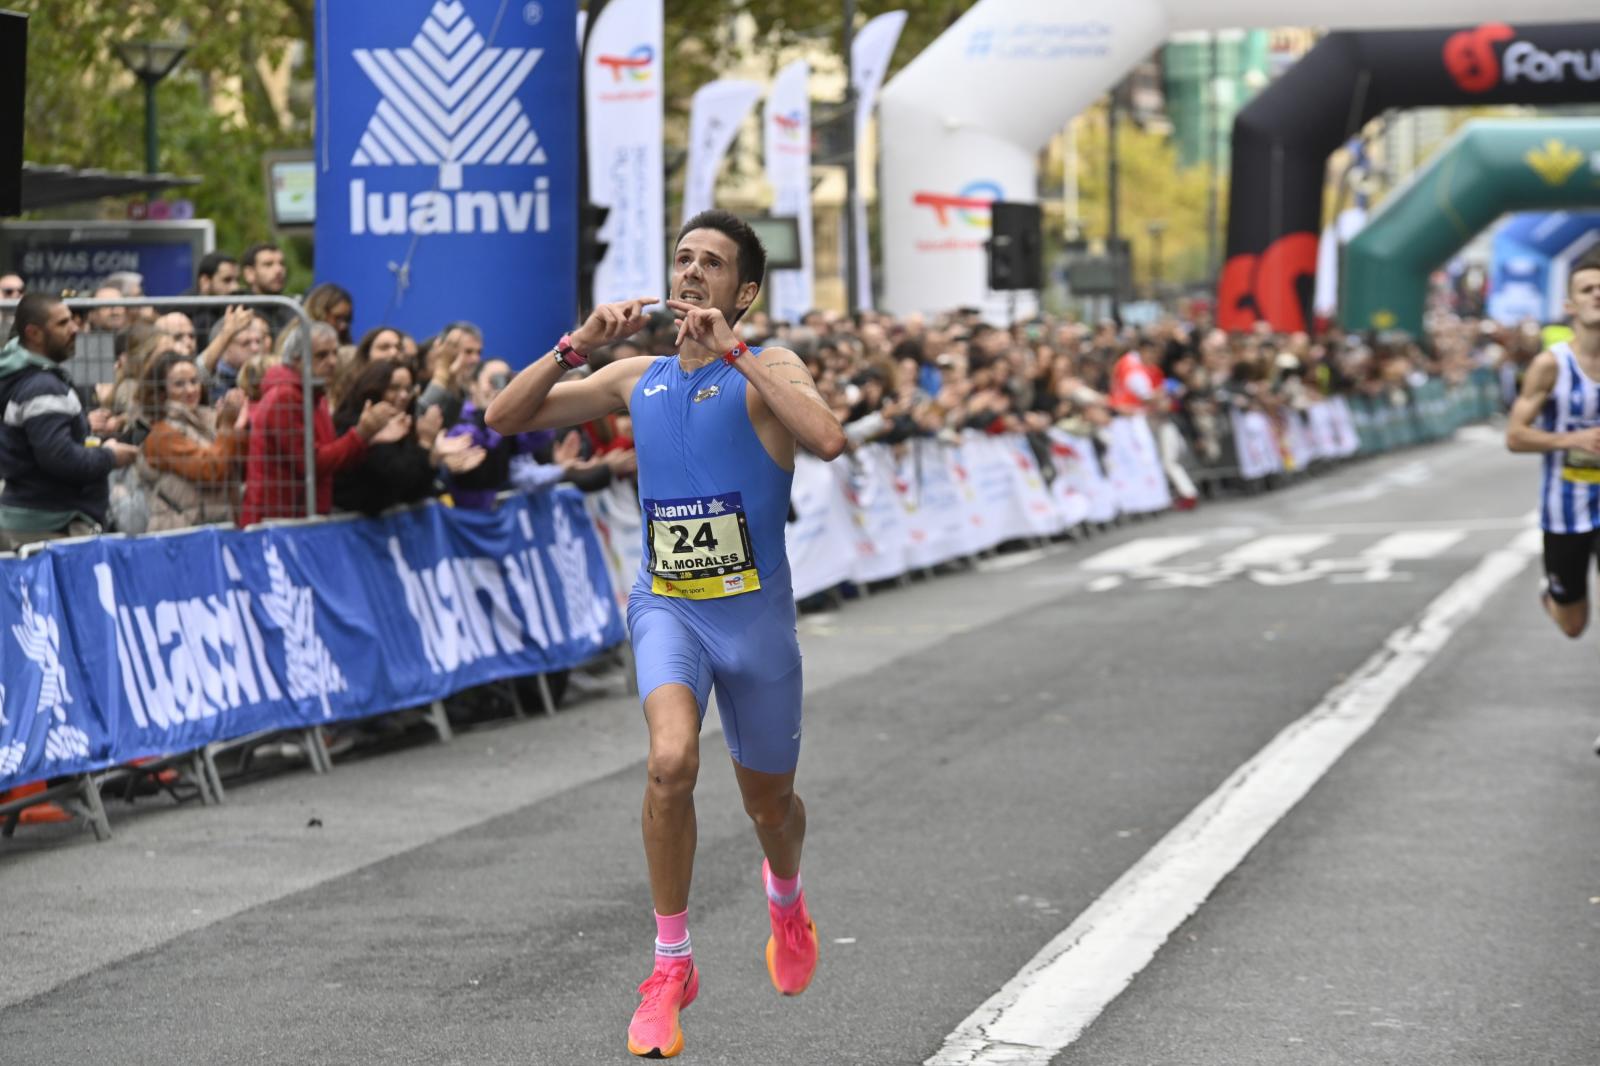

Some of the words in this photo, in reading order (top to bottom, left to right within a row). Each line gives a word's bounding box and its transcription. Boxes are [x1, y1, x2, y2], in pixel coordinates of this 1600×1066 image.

[350, 176, 550, 235] luanvi
[23, 251, 44, 272] SI
[49, 251, 89, 272] VAS
[92, 251, 140, 271] CON
[654, 500, 704, 518] luanvi
[669, 522, 719, 554] 24
[662, 560, 673, 570] R.
[675, 553, 739, 569] MORALES
[388, 509, 565, 675] luanvi
[93, 545, 282, 731] luanvi
